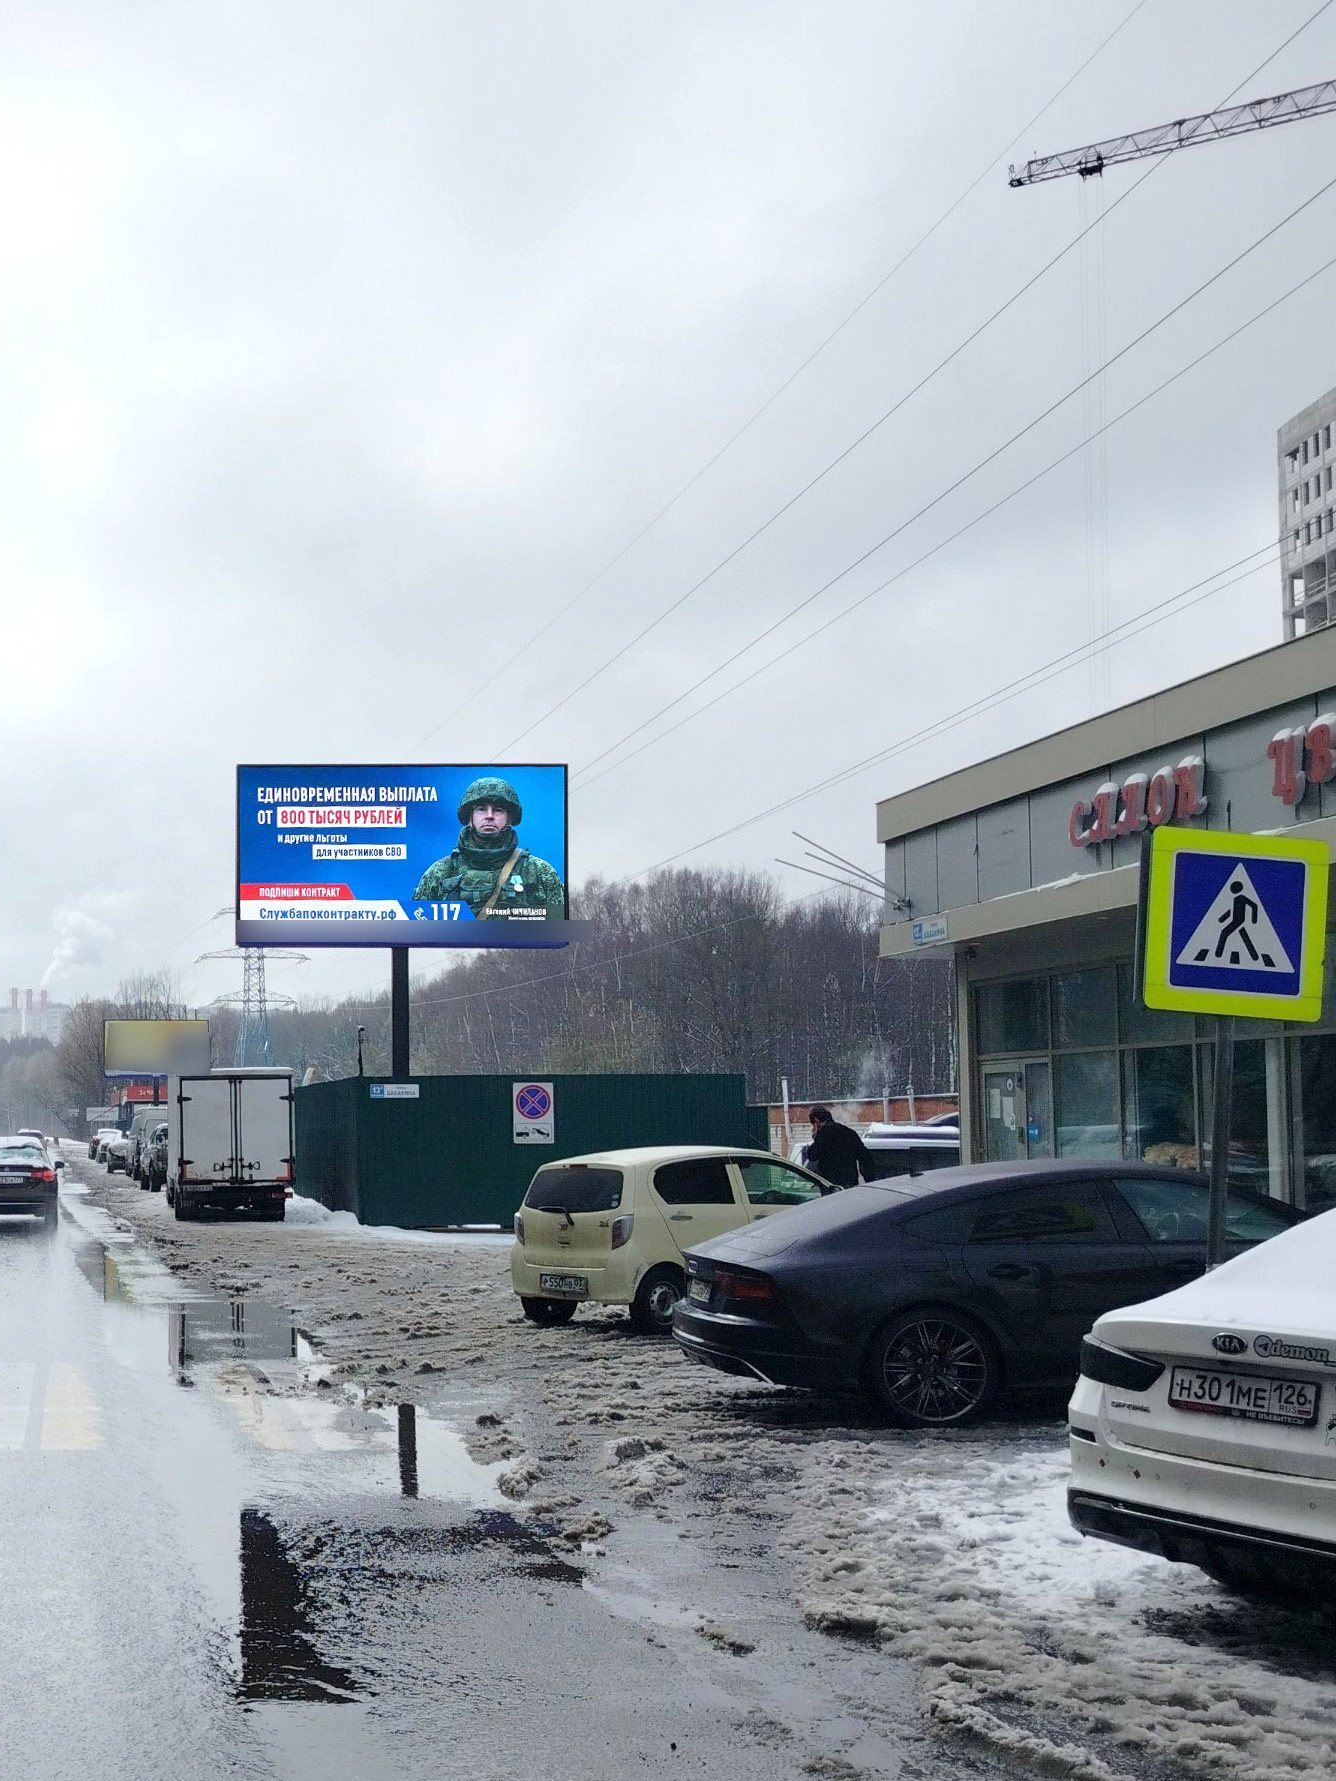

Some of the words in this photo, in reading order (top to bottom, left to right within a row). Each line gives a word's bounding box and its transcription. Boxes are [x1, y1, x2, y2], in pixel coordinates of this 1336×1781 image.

[257, 787, 376, 804] ЕДИНОВРЕМЕННАЯ
[379, 786, 438, 802] ВЫПЛАТА
[1068, 757, 1207, 848] САЛОН
[257, 809, 273, 825] ОТ
[280, 810, 305, 825] 800
[308, 810, 351, 825] ТЫСЯЧ
[354, 807, 403, 825] РУБЛЕЙ
[277, 834, 283, 843] и
[284, 834, 314, 844] другие
[315, 834, 348, 843] льготы
[315, 848, 332, 858] для
[334, 848, 384, 859] участников
[385, 847, 402, 857] СВО
[259, 887, 300, 898] ПОДПИШИ
[301, 887, 341, 897] КОНТРАКТ
[259, 907, 397, 920] Службапоконтракту.рф
[430, 903, 461, 921] 117
[1216, 1336, 1241, 1350] KIA
[1278, 1404, 1298, 1414] RUS
